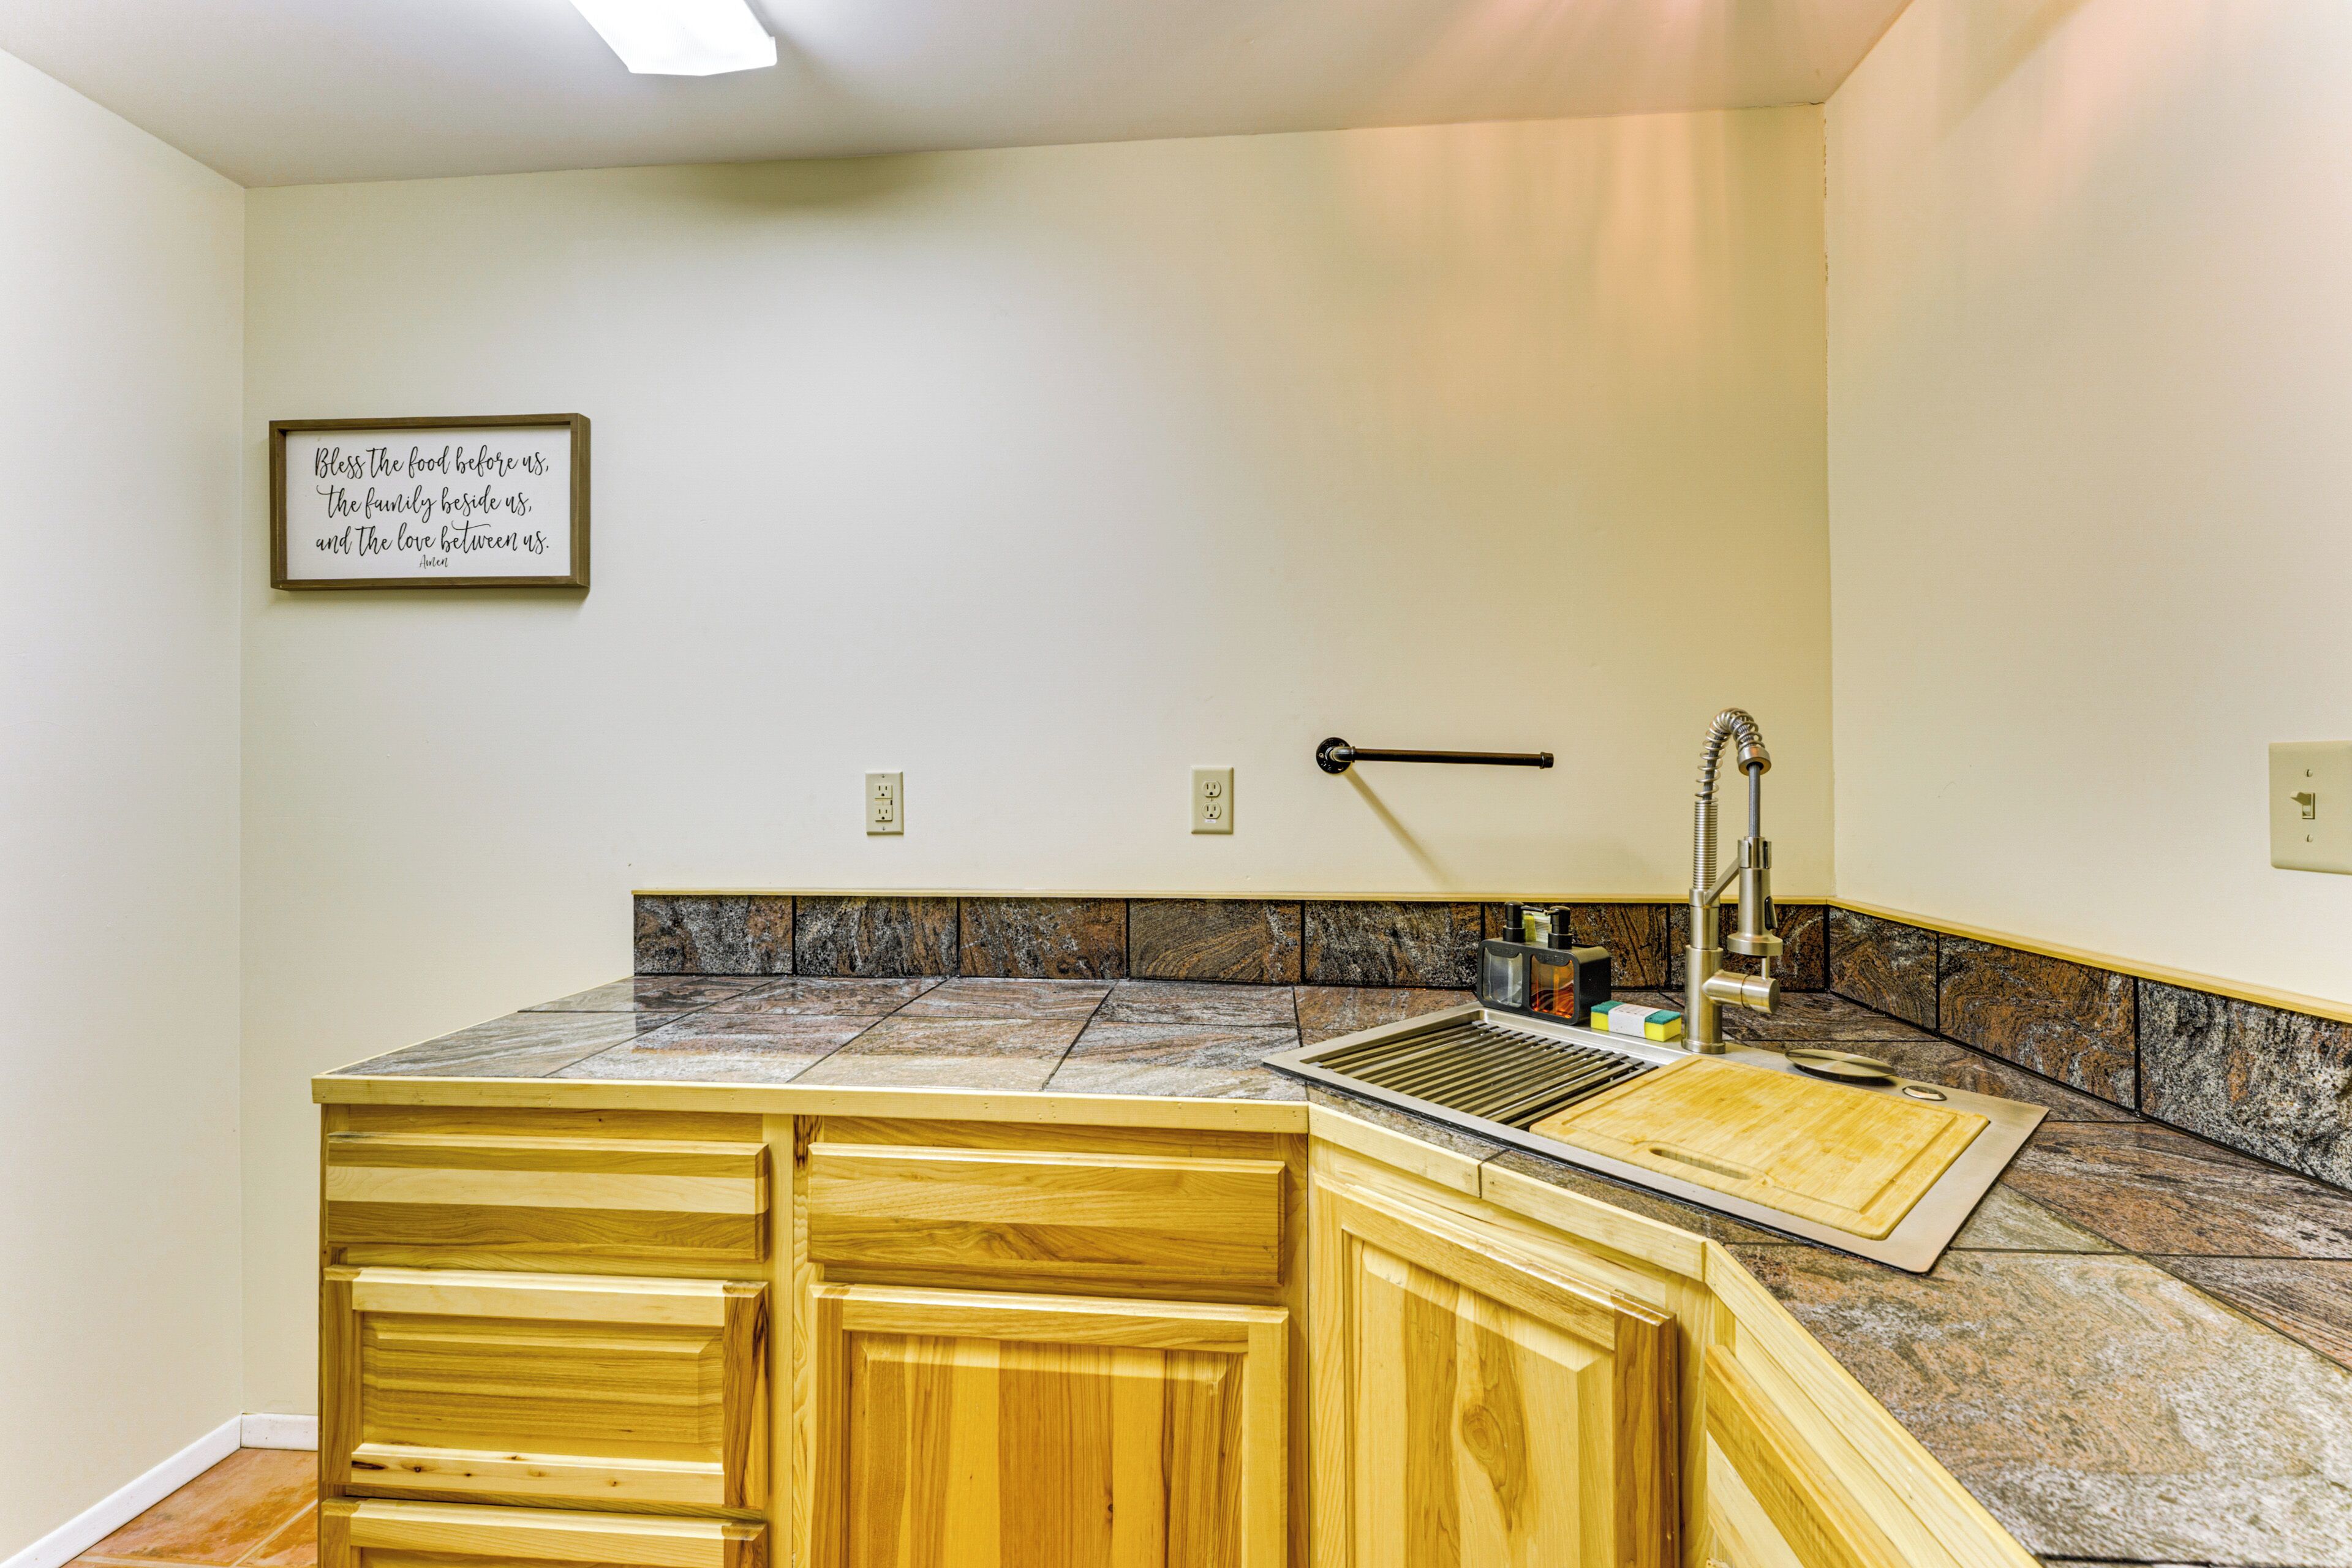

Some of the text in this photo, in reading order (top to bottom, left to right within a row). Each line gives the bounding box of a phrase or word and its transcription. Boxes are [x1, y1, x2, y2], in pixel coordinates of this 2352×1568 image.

[315, 447, 366, 480] Bless
[409, 445, 451, 479] food
[456, 445, 519, 478] before
[522, 451, 549, 476] us,
[316, 484, 532, 524] the family beside us,
[315, 526, 353, 555] and
[398, 522, 437, 552] love
[440, 520, 518, 554] between
[523, 530, 549, 555] us.
[419, 554, 448, 569] Amen
[1538, 953, 1564, 963] DISHES
